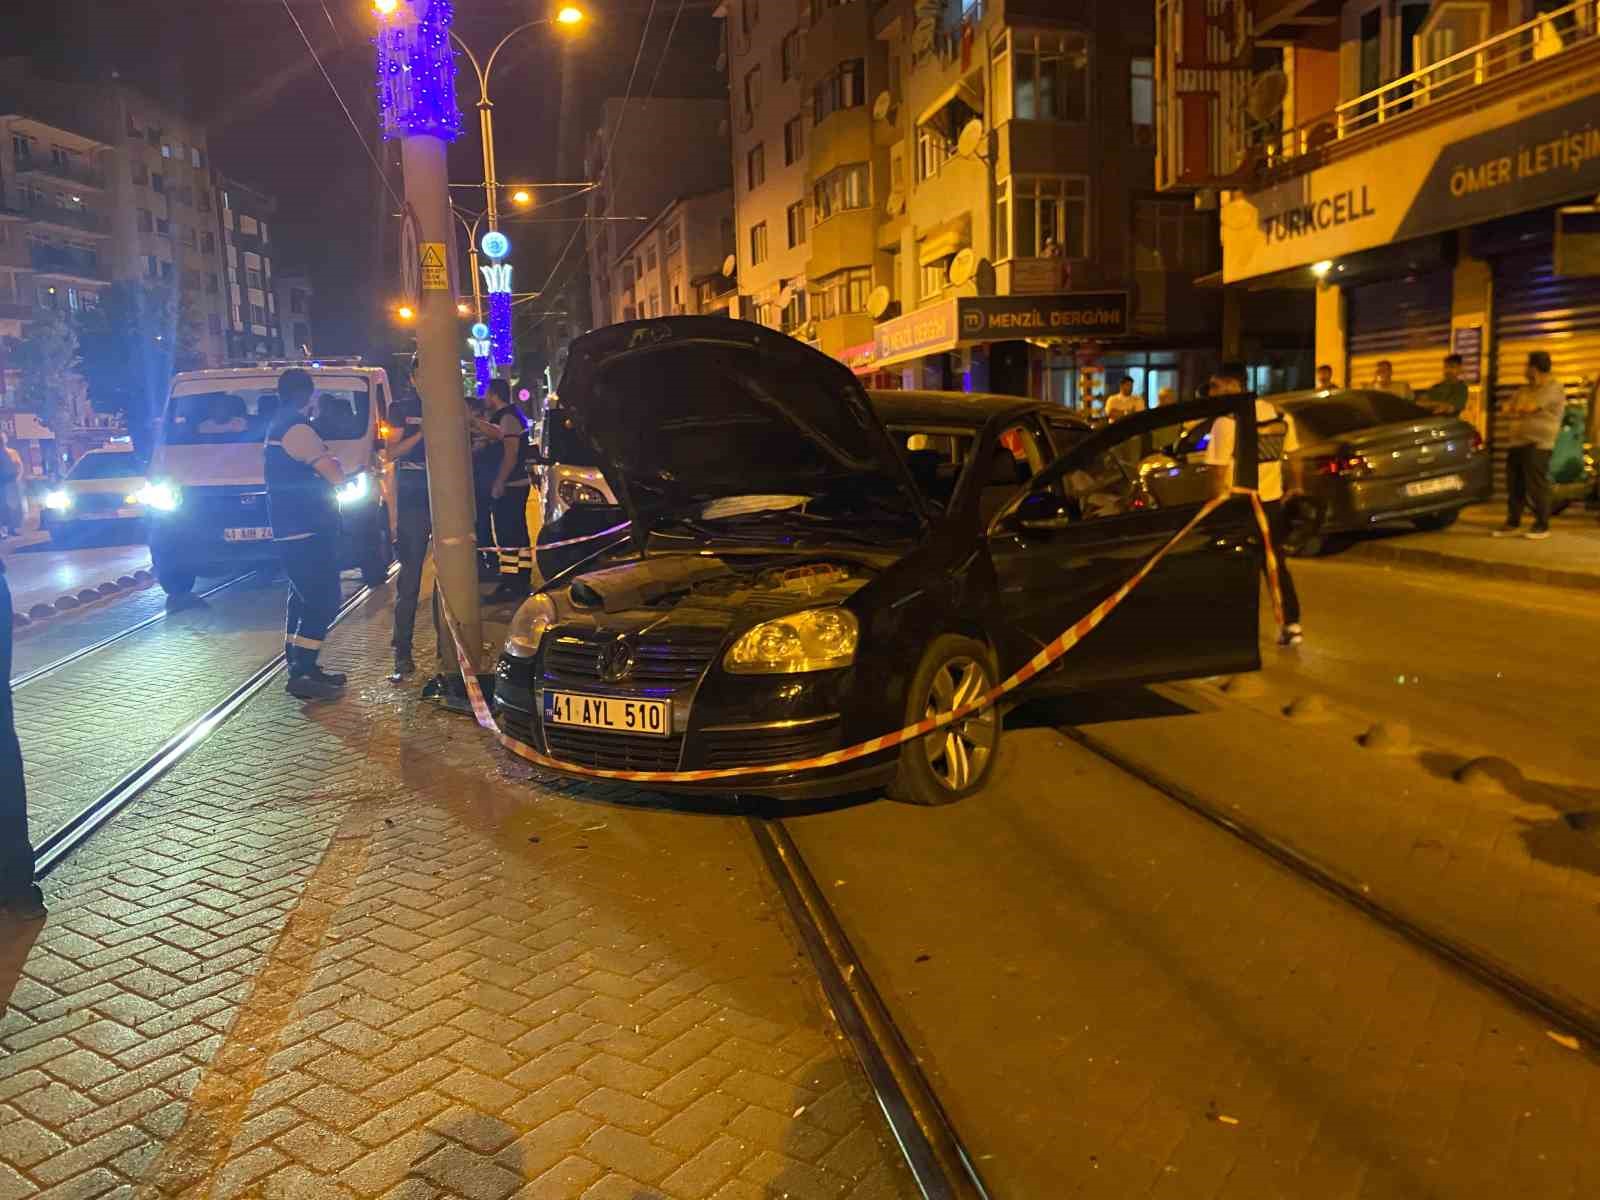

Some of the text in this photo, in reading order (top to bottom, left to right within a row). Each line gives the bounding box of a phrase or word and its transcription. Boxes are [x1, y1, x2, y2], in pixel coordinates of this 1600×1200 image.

[1450, 156, 1512, 197] ÖMER
[1263, 185, 1375, 245] TURKCELL
[988, 307, 1046, 328] MENZİL
[553, 696, 660, 730] 41 AYL 510
